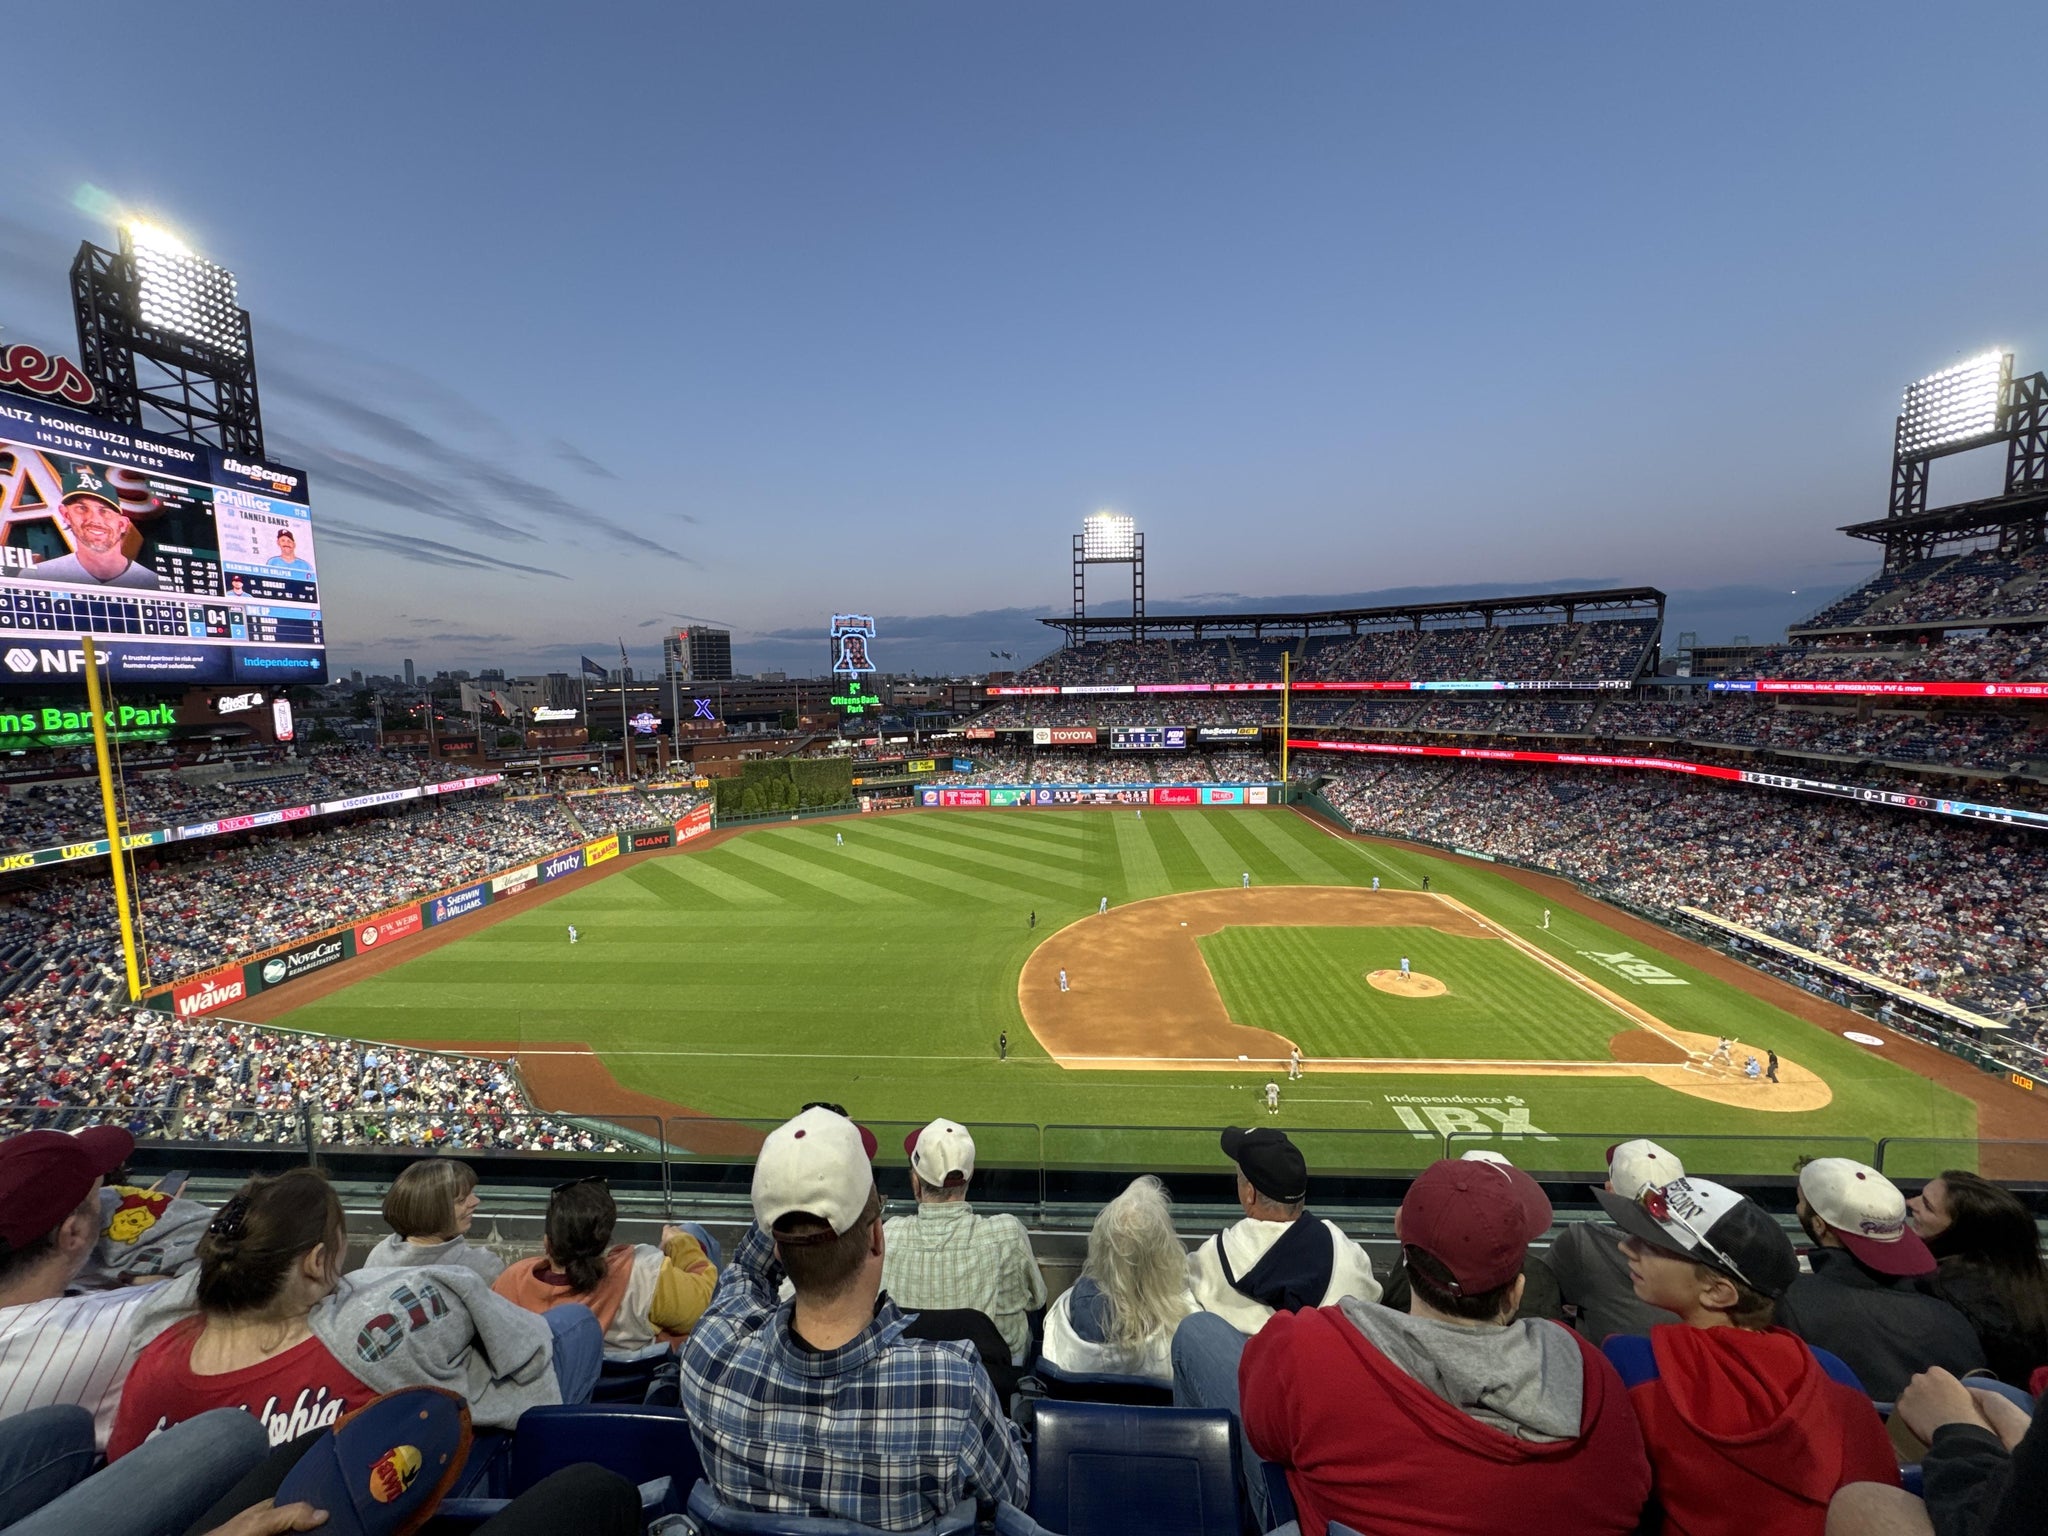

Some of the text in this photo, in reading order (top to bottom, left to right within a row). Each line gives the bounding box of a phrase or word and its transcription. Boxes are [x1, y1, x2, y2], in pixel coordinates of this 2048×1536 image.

[40, 415, 130, 447] MONGELUZZI
[134, 439, 196, 462] BENDESKY
[36, 431, 164, 468] INJURY LAWYERS
[223, 458, 298, 486] theScore
[213, 490, 271, 512] Phillies
[239, 510, 266, 524] TANNER
[267, 516, 289, 527] BANKS
[20, 600, 28, 608] 3
[40, 601, 47, 609] 1
[59, 603, 66, 611] 1
[145, 609, 153, 617] 9
[193, 612, 199, 620] 3
[1, 616, 10, 624] 0
[22, 617, 30, 625] 0
[43, 618, 49, 626] 1
[244, 657, 309, 668] Independence
[830, 694, 880, 706] Citizens Bank
[847, 705, 864, 713] Park
[119, 703, 177, 726] Park
[1052, 731, 1093, 740] TOYOTA
[1200, 727, 1237, 736] theScore
[442, 742, 475, 751] GIANT
[439, 775, 498, 791] TOYOTA TOYOTA
[342, 791, 404, 808] LISCIO'S BAKERY
[959, 791, 983, 800] Temple
[221, 808, 310, 831] NECA NECA
[635, 834, 670, 848] GIANT
[0, 834, 153, 871] UKG UKG UKG
[546, 854, 580, 878] xfinity
[446, 888, 480, 908] SHERWIN
[395, 913, 419, 927] WEBB
[288, 931, 329, 949] ASPLUNDH
[234, 949, 280, 968] ASPLUNDH
[287, 940, 343, 968] NovaCare
[288, 953, 341, 977] REHABILITATION
[172, 967, 225, 989] ASPLUNDH
[179, 981, 243, 1016] Wawa
[1384, 1094, 1503, 1105] Independence
[1392, 1105, 1561, 1142] IBX
